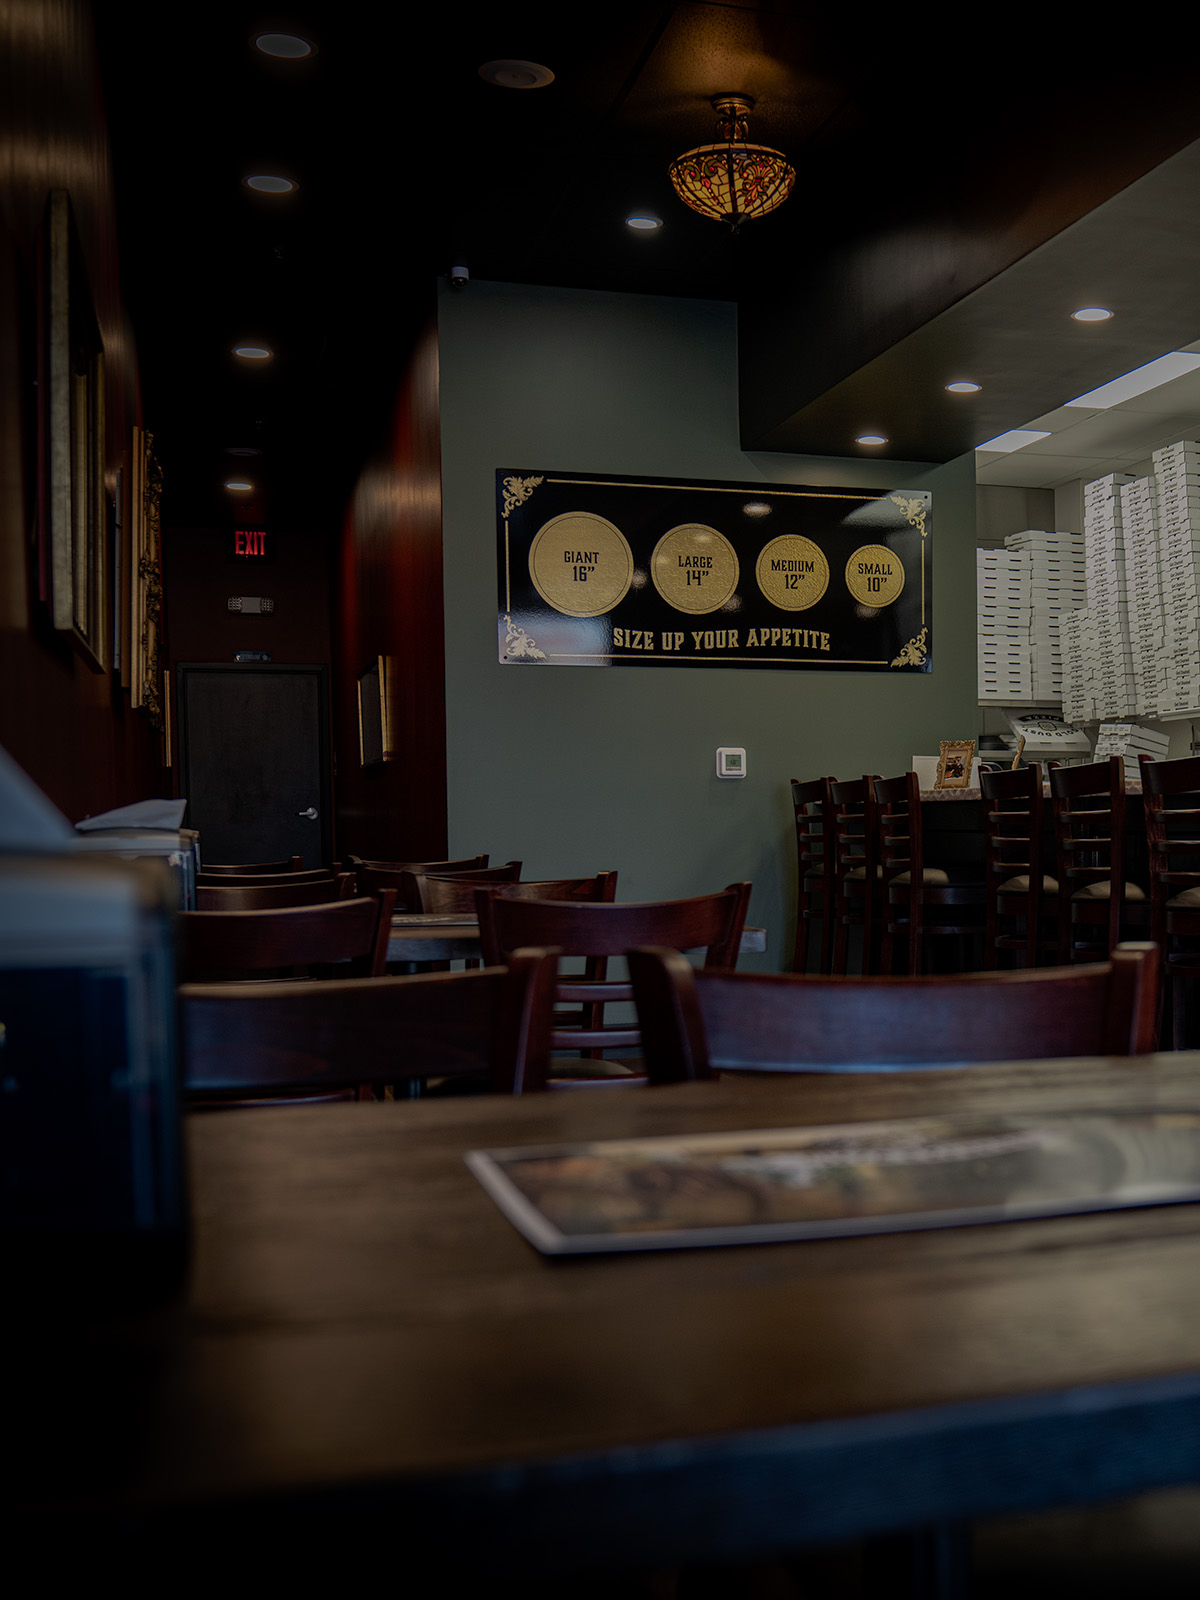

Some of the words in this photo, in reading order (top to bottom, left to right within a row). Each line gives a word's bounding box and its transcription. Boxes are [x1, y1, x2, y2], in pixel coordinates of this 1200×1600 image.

[235, 531, 266, 555] EXIT
[564, 550, 599, 565] GIANT
[678, 555, 713, 569] LARGE
[771, 559, 814, 573] MEDIUM
[858, 563, 892, 576] SMALL
[613, 627, 654, 650] SIZE
[662, 632, 684, 650] UP
[691, 630, 739, 650] YOUR
[746, 628, 830, 651] APPETITE
